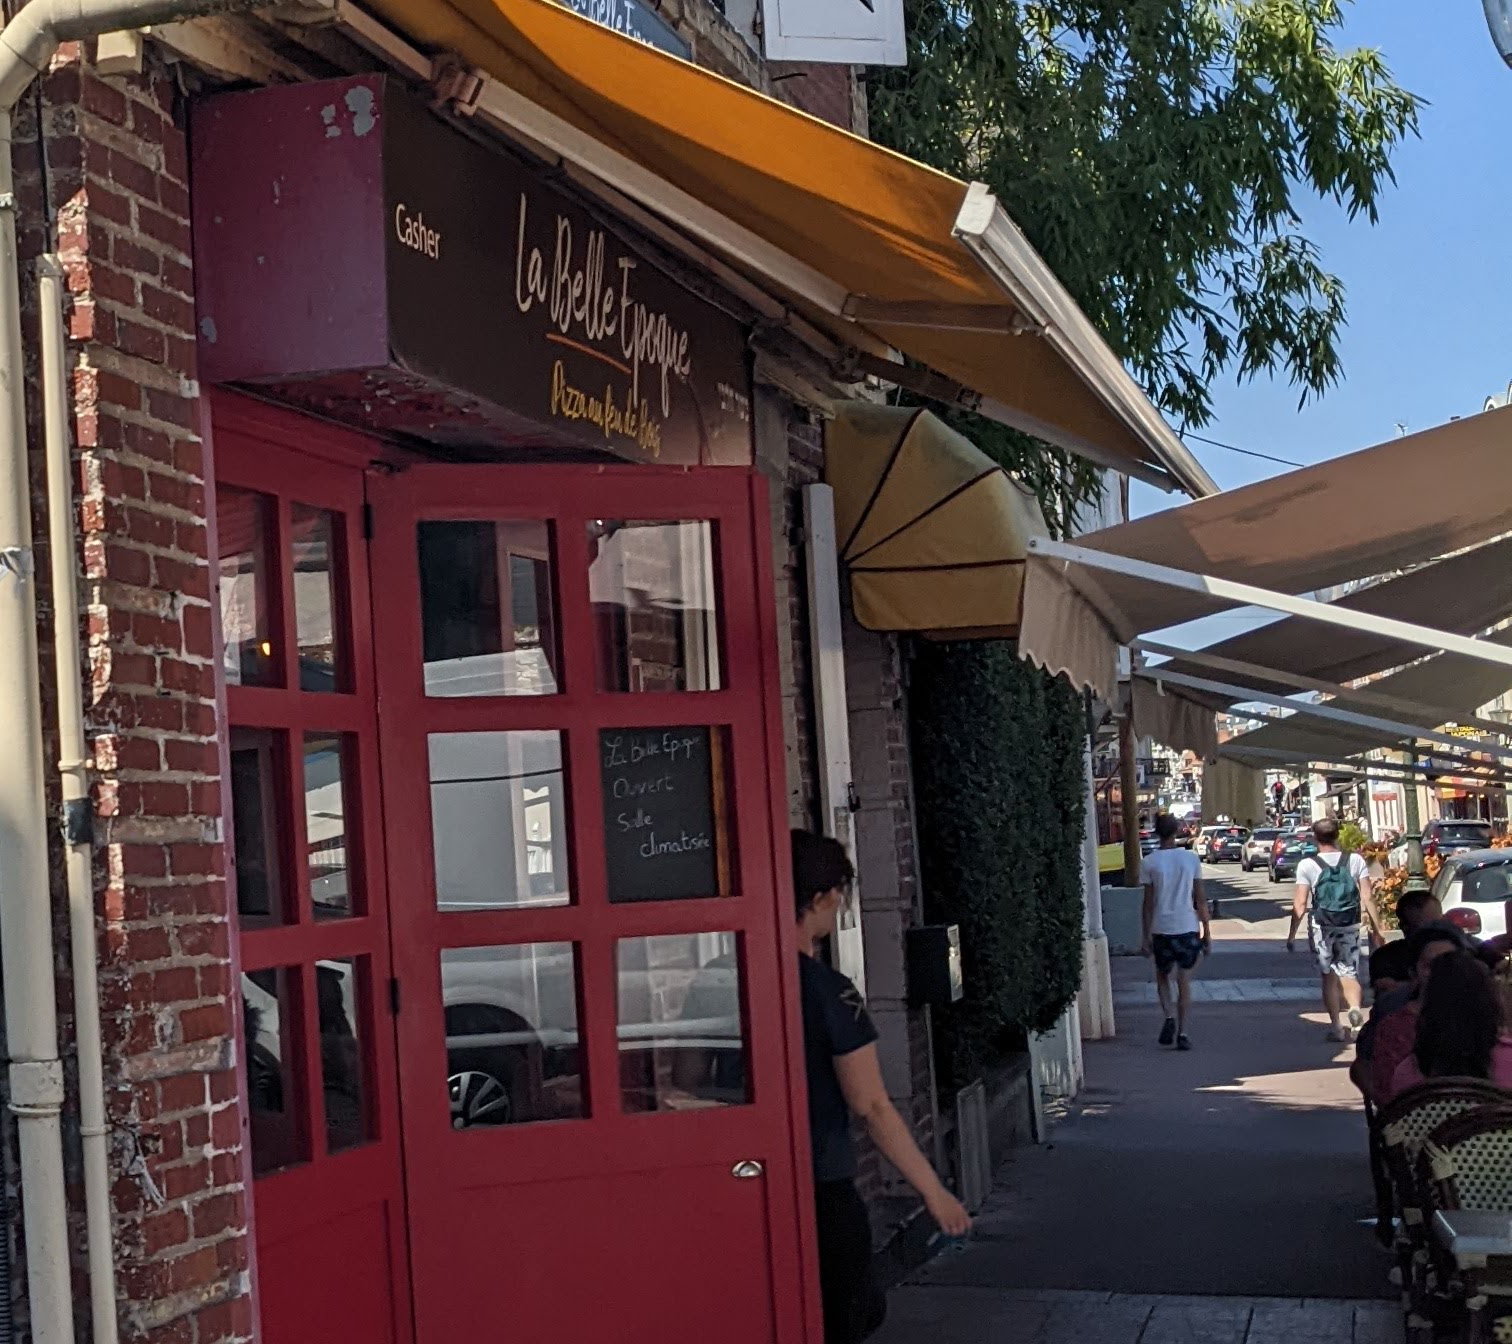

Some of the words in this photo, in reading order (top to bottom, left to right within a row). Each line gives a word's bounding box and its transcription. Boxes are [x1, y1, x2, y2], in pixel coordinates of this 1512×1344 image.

[395, 203, 441, 259] Casher
[516, 193, 547, 312] La
[551, 214, 617, 340] Belle
[619, 257, 691, 418] Epoque
[551, 360, 587, 418] Pizza
